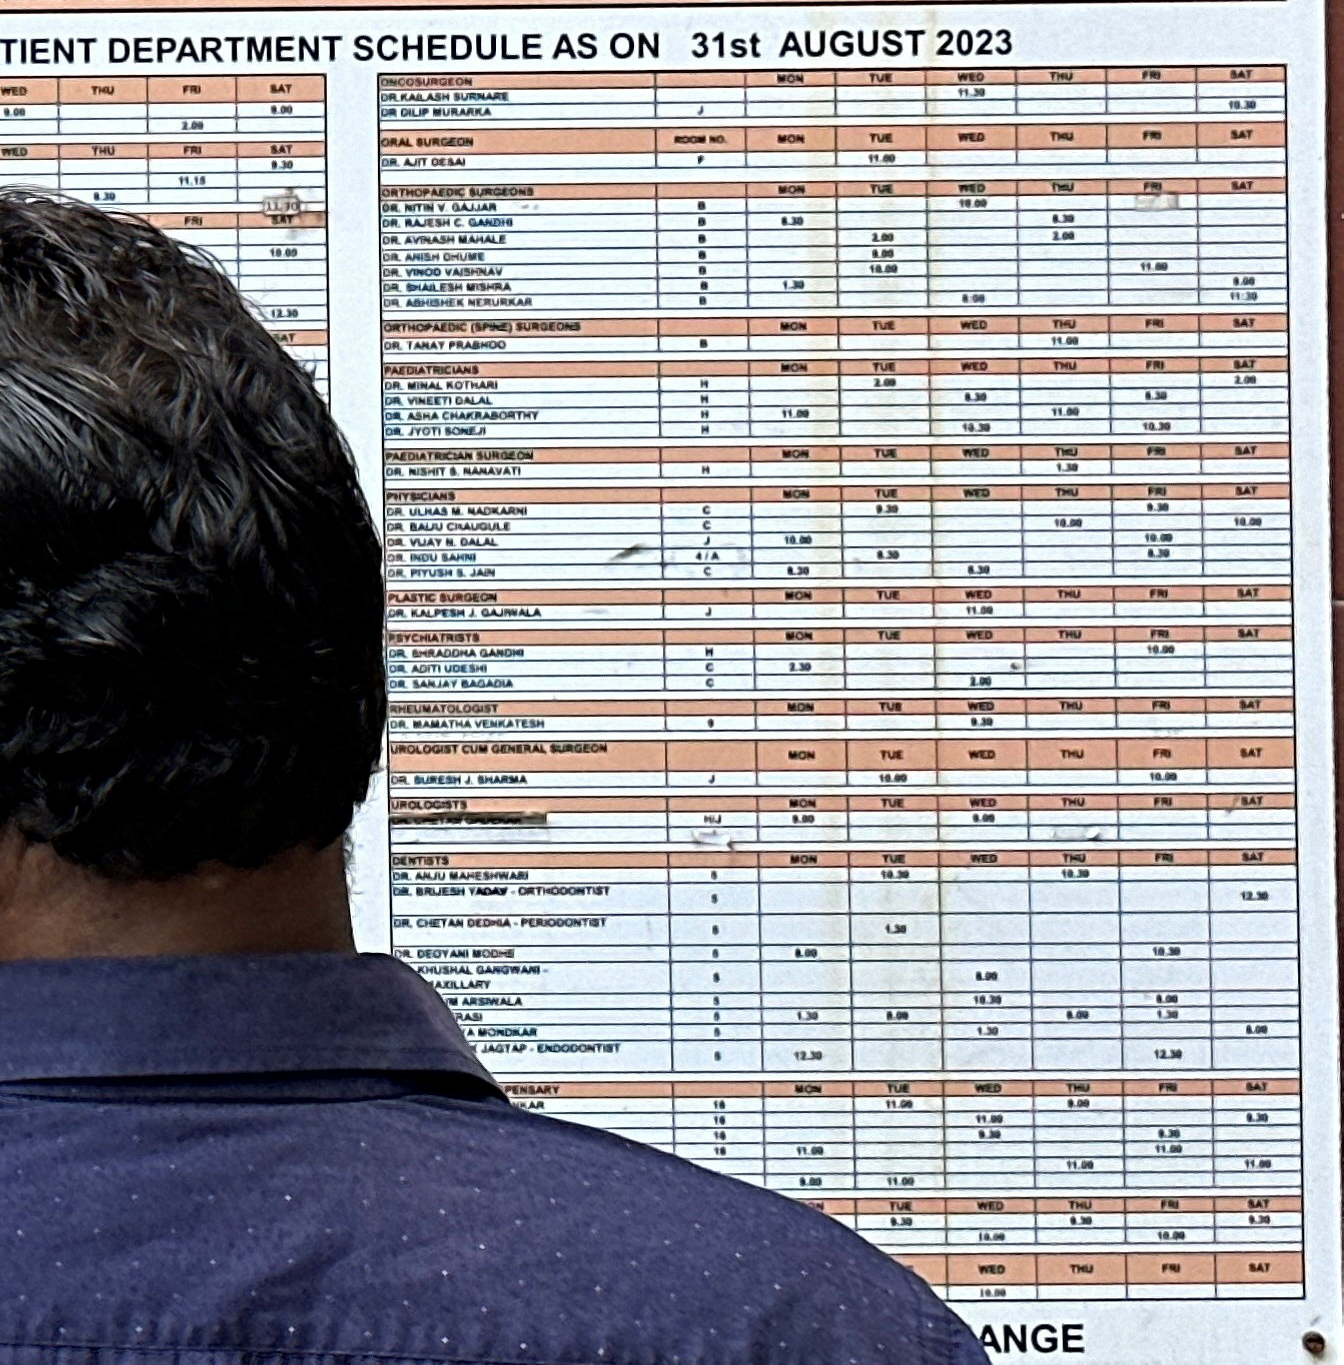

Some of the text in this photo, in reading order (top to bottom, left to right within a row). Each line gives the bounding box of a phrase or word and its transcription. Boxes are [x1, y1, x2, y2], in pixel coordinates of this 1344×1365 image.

[109, 36, 342, 63] DEPARTMENT
[354, 34, 542, 61] SCHEDULE
[553, 33, 597, 59] AS
[610, 33, 658, 59] ON
[692, 32, 760, 58] 31st
[780, 30, 925, 57] AUGUST
[937, 29, 1012, 55] 2023
[777, 72, 804, 84] MON
[870, 72, 892, 84] TUE
[1050, 71, 1074, 83] THU
[0, 86, 27, 96] WED
[91, 85, 115, 96] THU
[183, 84, 201, 95] FRI
[270, 84, 292, 94] SAT
[381, 137, 474, 147] ORAL SURGEON
[381, 187, 534, 197] ORTHOPAEDIC SURGEONS
[384, 365, 479, 376] PAEDIATRICIANS
[386, 491, 455, 501] PHYSICIANS
[388, 593, 498, 603] PLASTIC SURGEON
[390, 704, 498, 714] RHEUMATOLOGIST
[390, 743, 608, 754] UROLOGIST CUM GENERAL SURGEON
[392, 856, 449, 866] DENTISTS
